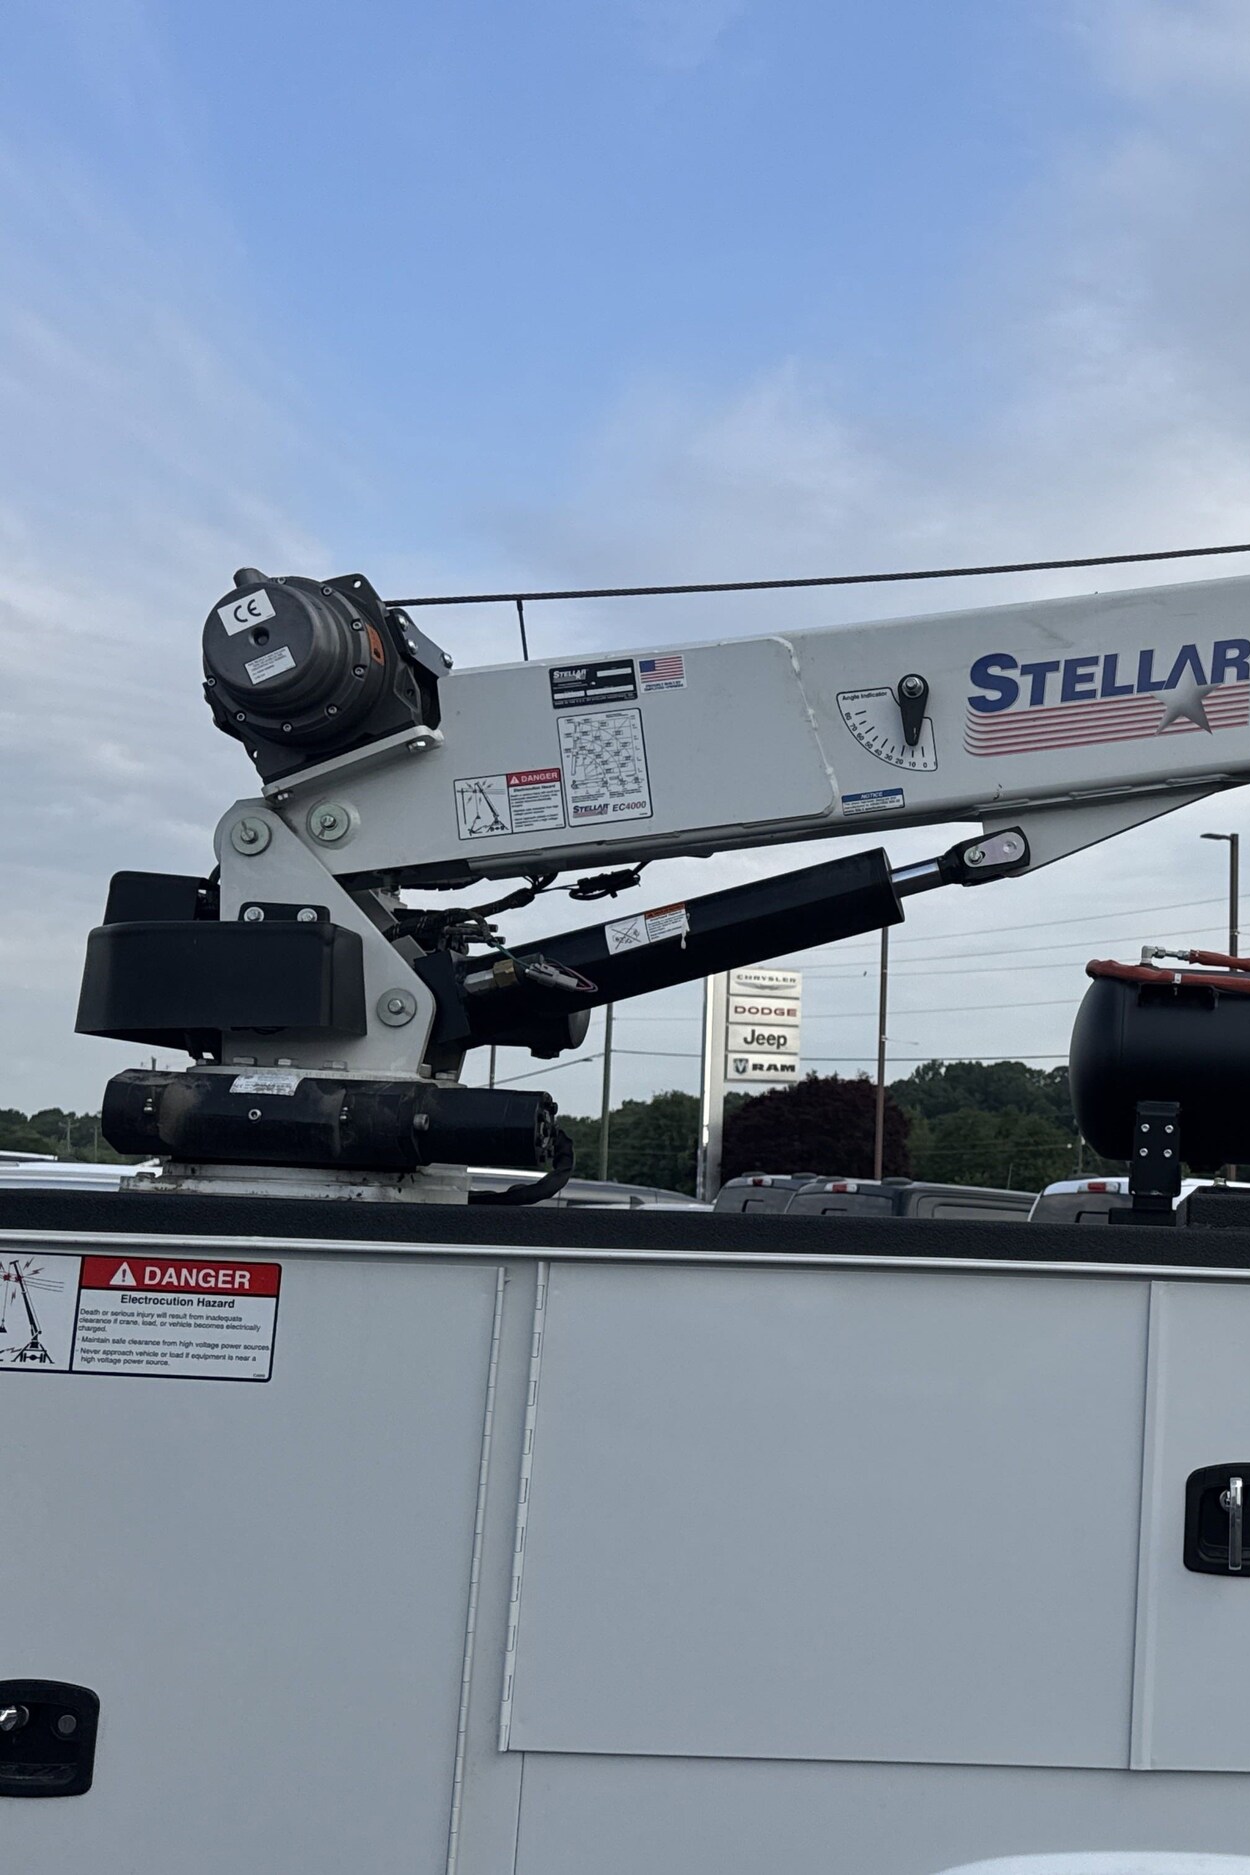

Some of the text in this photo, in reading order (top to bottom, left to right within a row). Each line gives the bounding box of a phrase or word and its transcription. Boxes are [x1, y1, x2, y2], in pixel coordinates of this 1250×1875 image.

[553, 669, 586, 678] STELLAR
[842, 691, 887, 702] Angle Indicator
[850, 723, 858, 731] 70
[857, 733, 864, 741] 60
[865, 741, 873, 749] 50
[521, 772, 557, 782] DANGER
[613, 801, 646, 812] EC4000
[737, 974, 796, 983] CHRYSLER
[734, 1006, 796, 1017] DODGE
[744, 1029, 787, 1050] Jeep
[752, 1064, 795, 1072] RAM
[144, 1266, 250, 1289] DANGER
[121, 1294, 235, 1308] Electrocution Hazard
[137, 1311, 154, 1319] injury
[206, 1314, 242, 1322] inadequate
[226, 1323, 261, 1332] electrically
[128, 1338, 160, 1346] clearance
[102, 1349, 133, 1357] approach
[191, 1353, 226, 1361] equipment
[81, 1356, 95, 1364] high
[97, 1357, 121, 1365] voltage
